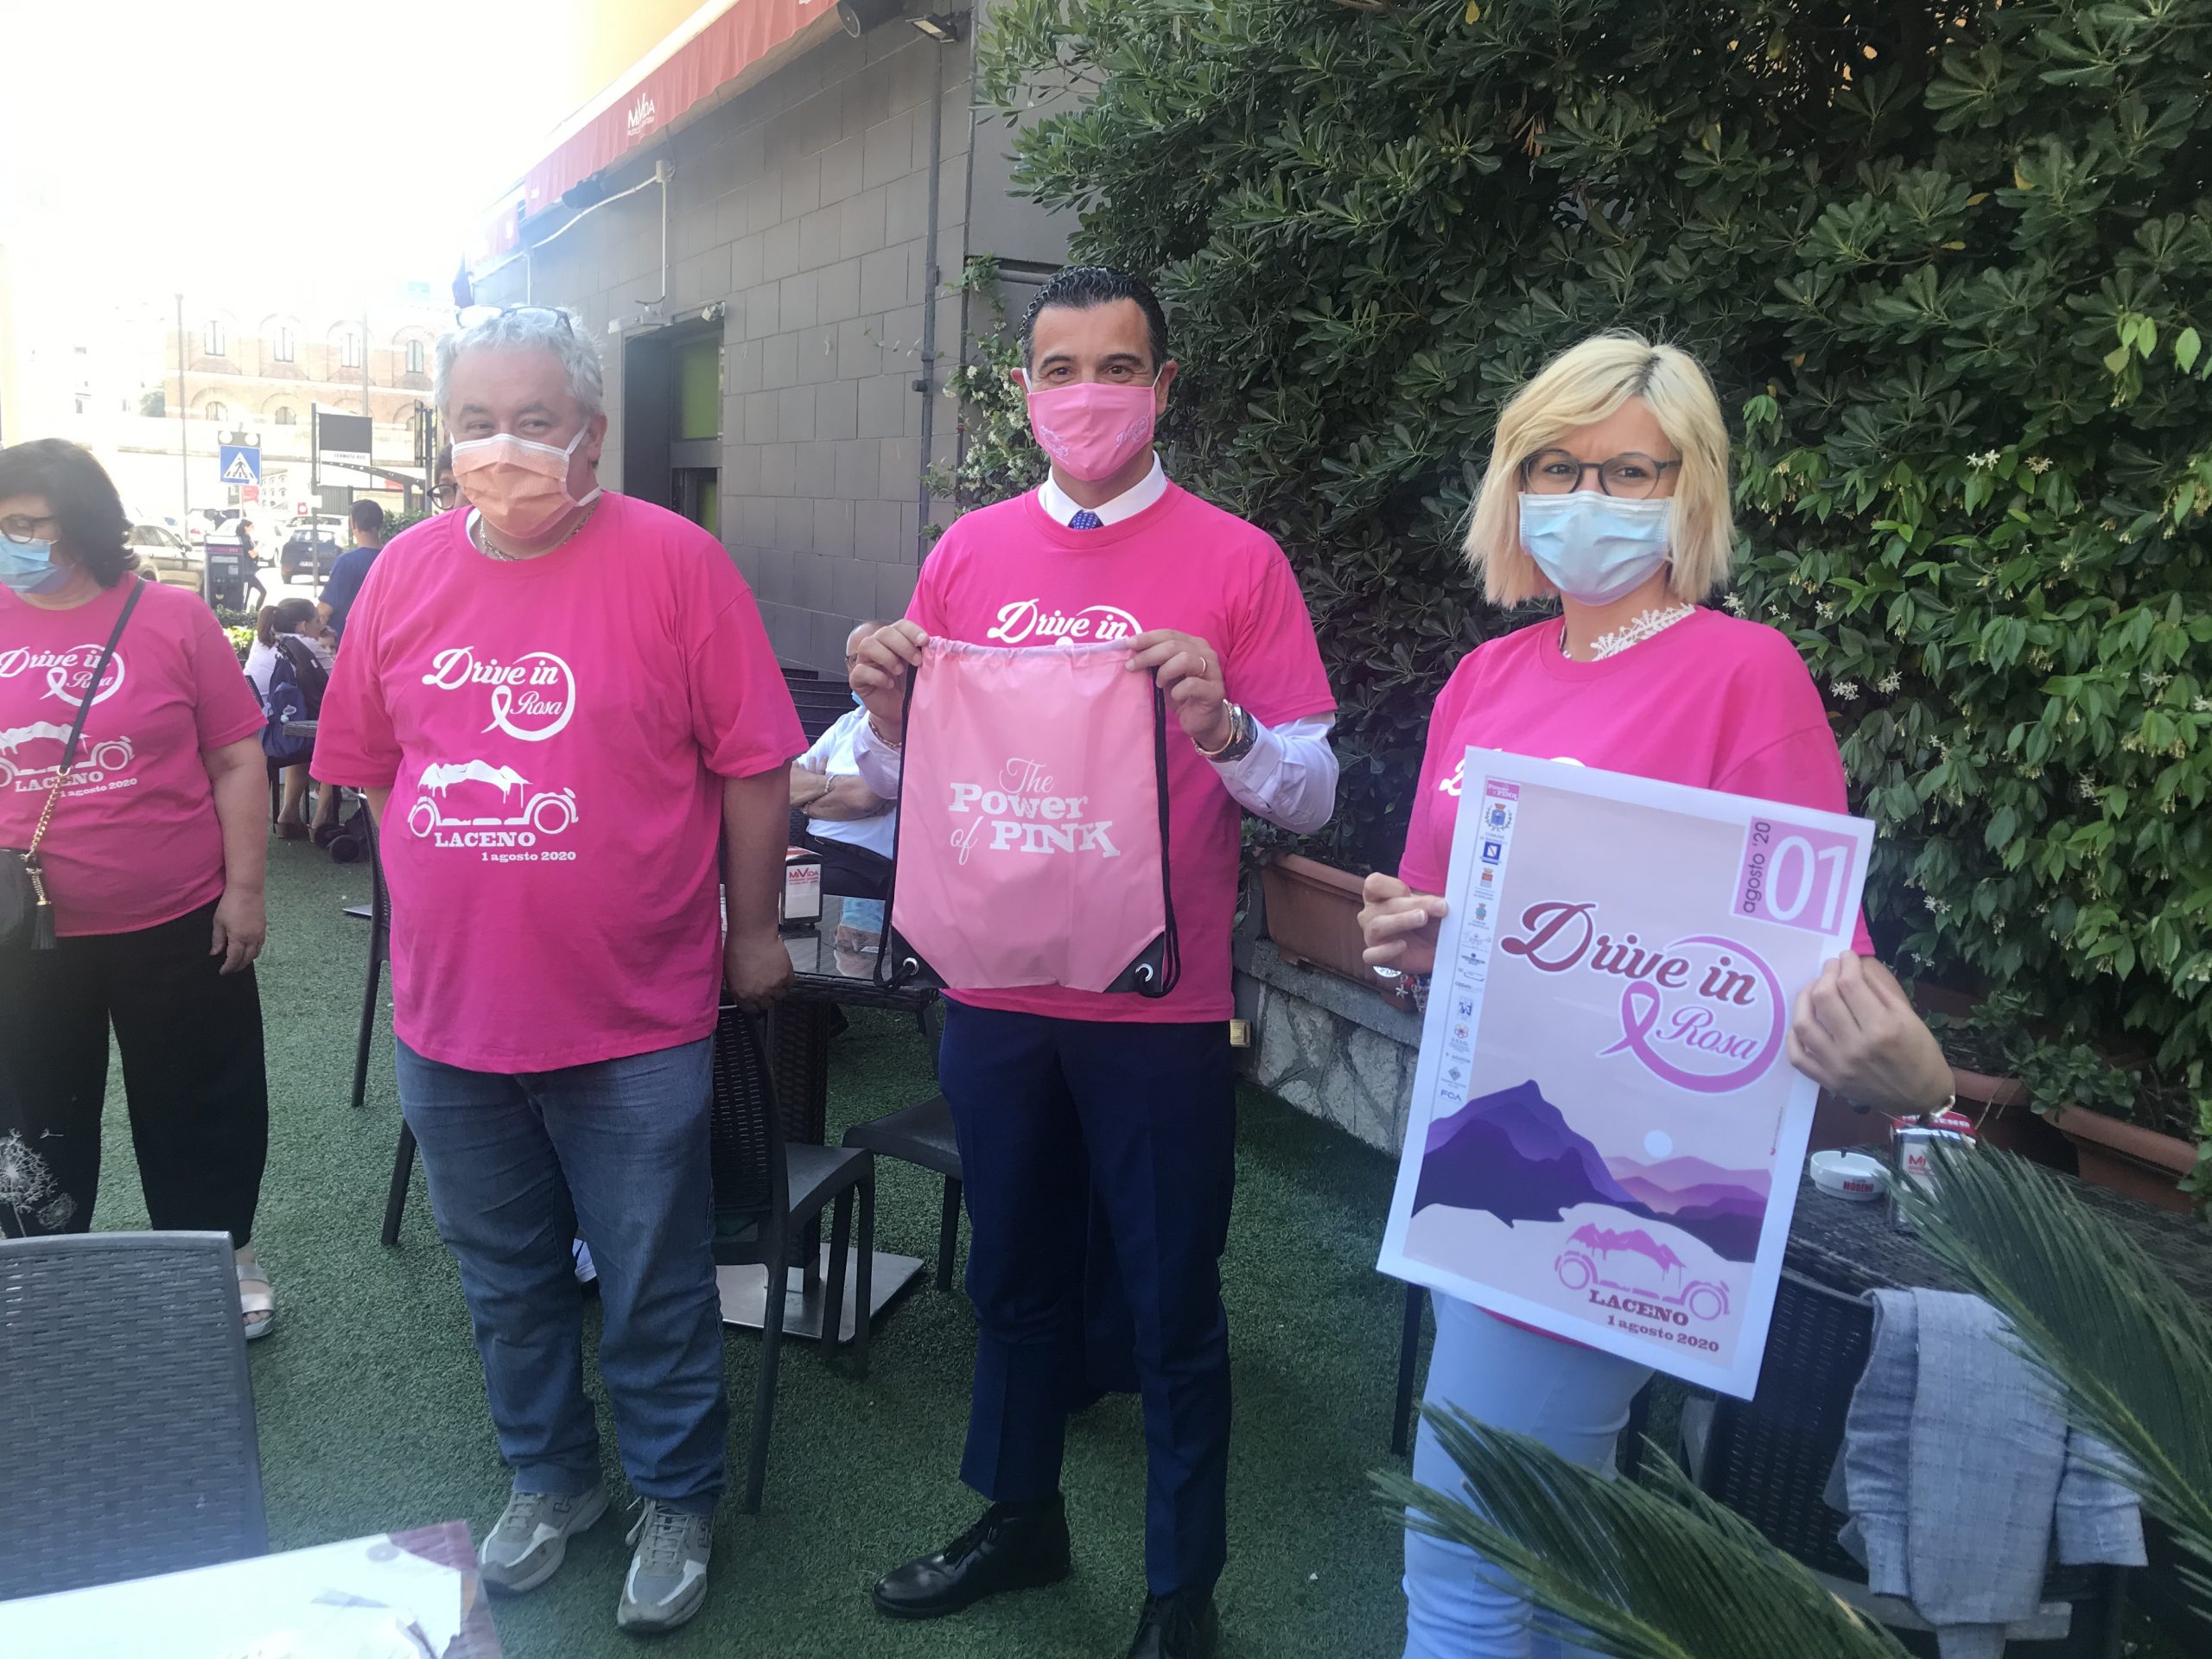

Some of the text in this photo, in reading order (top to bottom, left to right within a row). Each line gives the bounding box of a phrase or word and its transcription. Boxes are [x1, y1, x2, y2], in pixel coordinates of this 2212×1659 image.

[987, 598, 1129, 644] Drive in
[0, 645, 79, 678] Drive
[422, 645, 559, 690] Drive in
[510, 690, 563, 715] Rosa
[67, 785, 108, 798] agosto
[108, 778, 138, 791] 2020
[999, 757, 1055, 794] The
[948, 782, 1090, 820] Power
[434, 831, 537, 848] LACENO
[481, 851, 577, 863] 1 agosto 2020
[950, 816, 1122, 866] of PINK
[1743, 853, 1765, 913] agosto
[1765, 836, 1848, 931] 01
[1501, 901, 1757, 1006] Drive in
[1655, 1006, 1758, 1060] Rosa
[1440, 1089, 1462, 1102] FCA
[1588, 1288, 1689, 1326] LACENO
[1608, 1314, 1719, 1353] 1 agosto 2020
